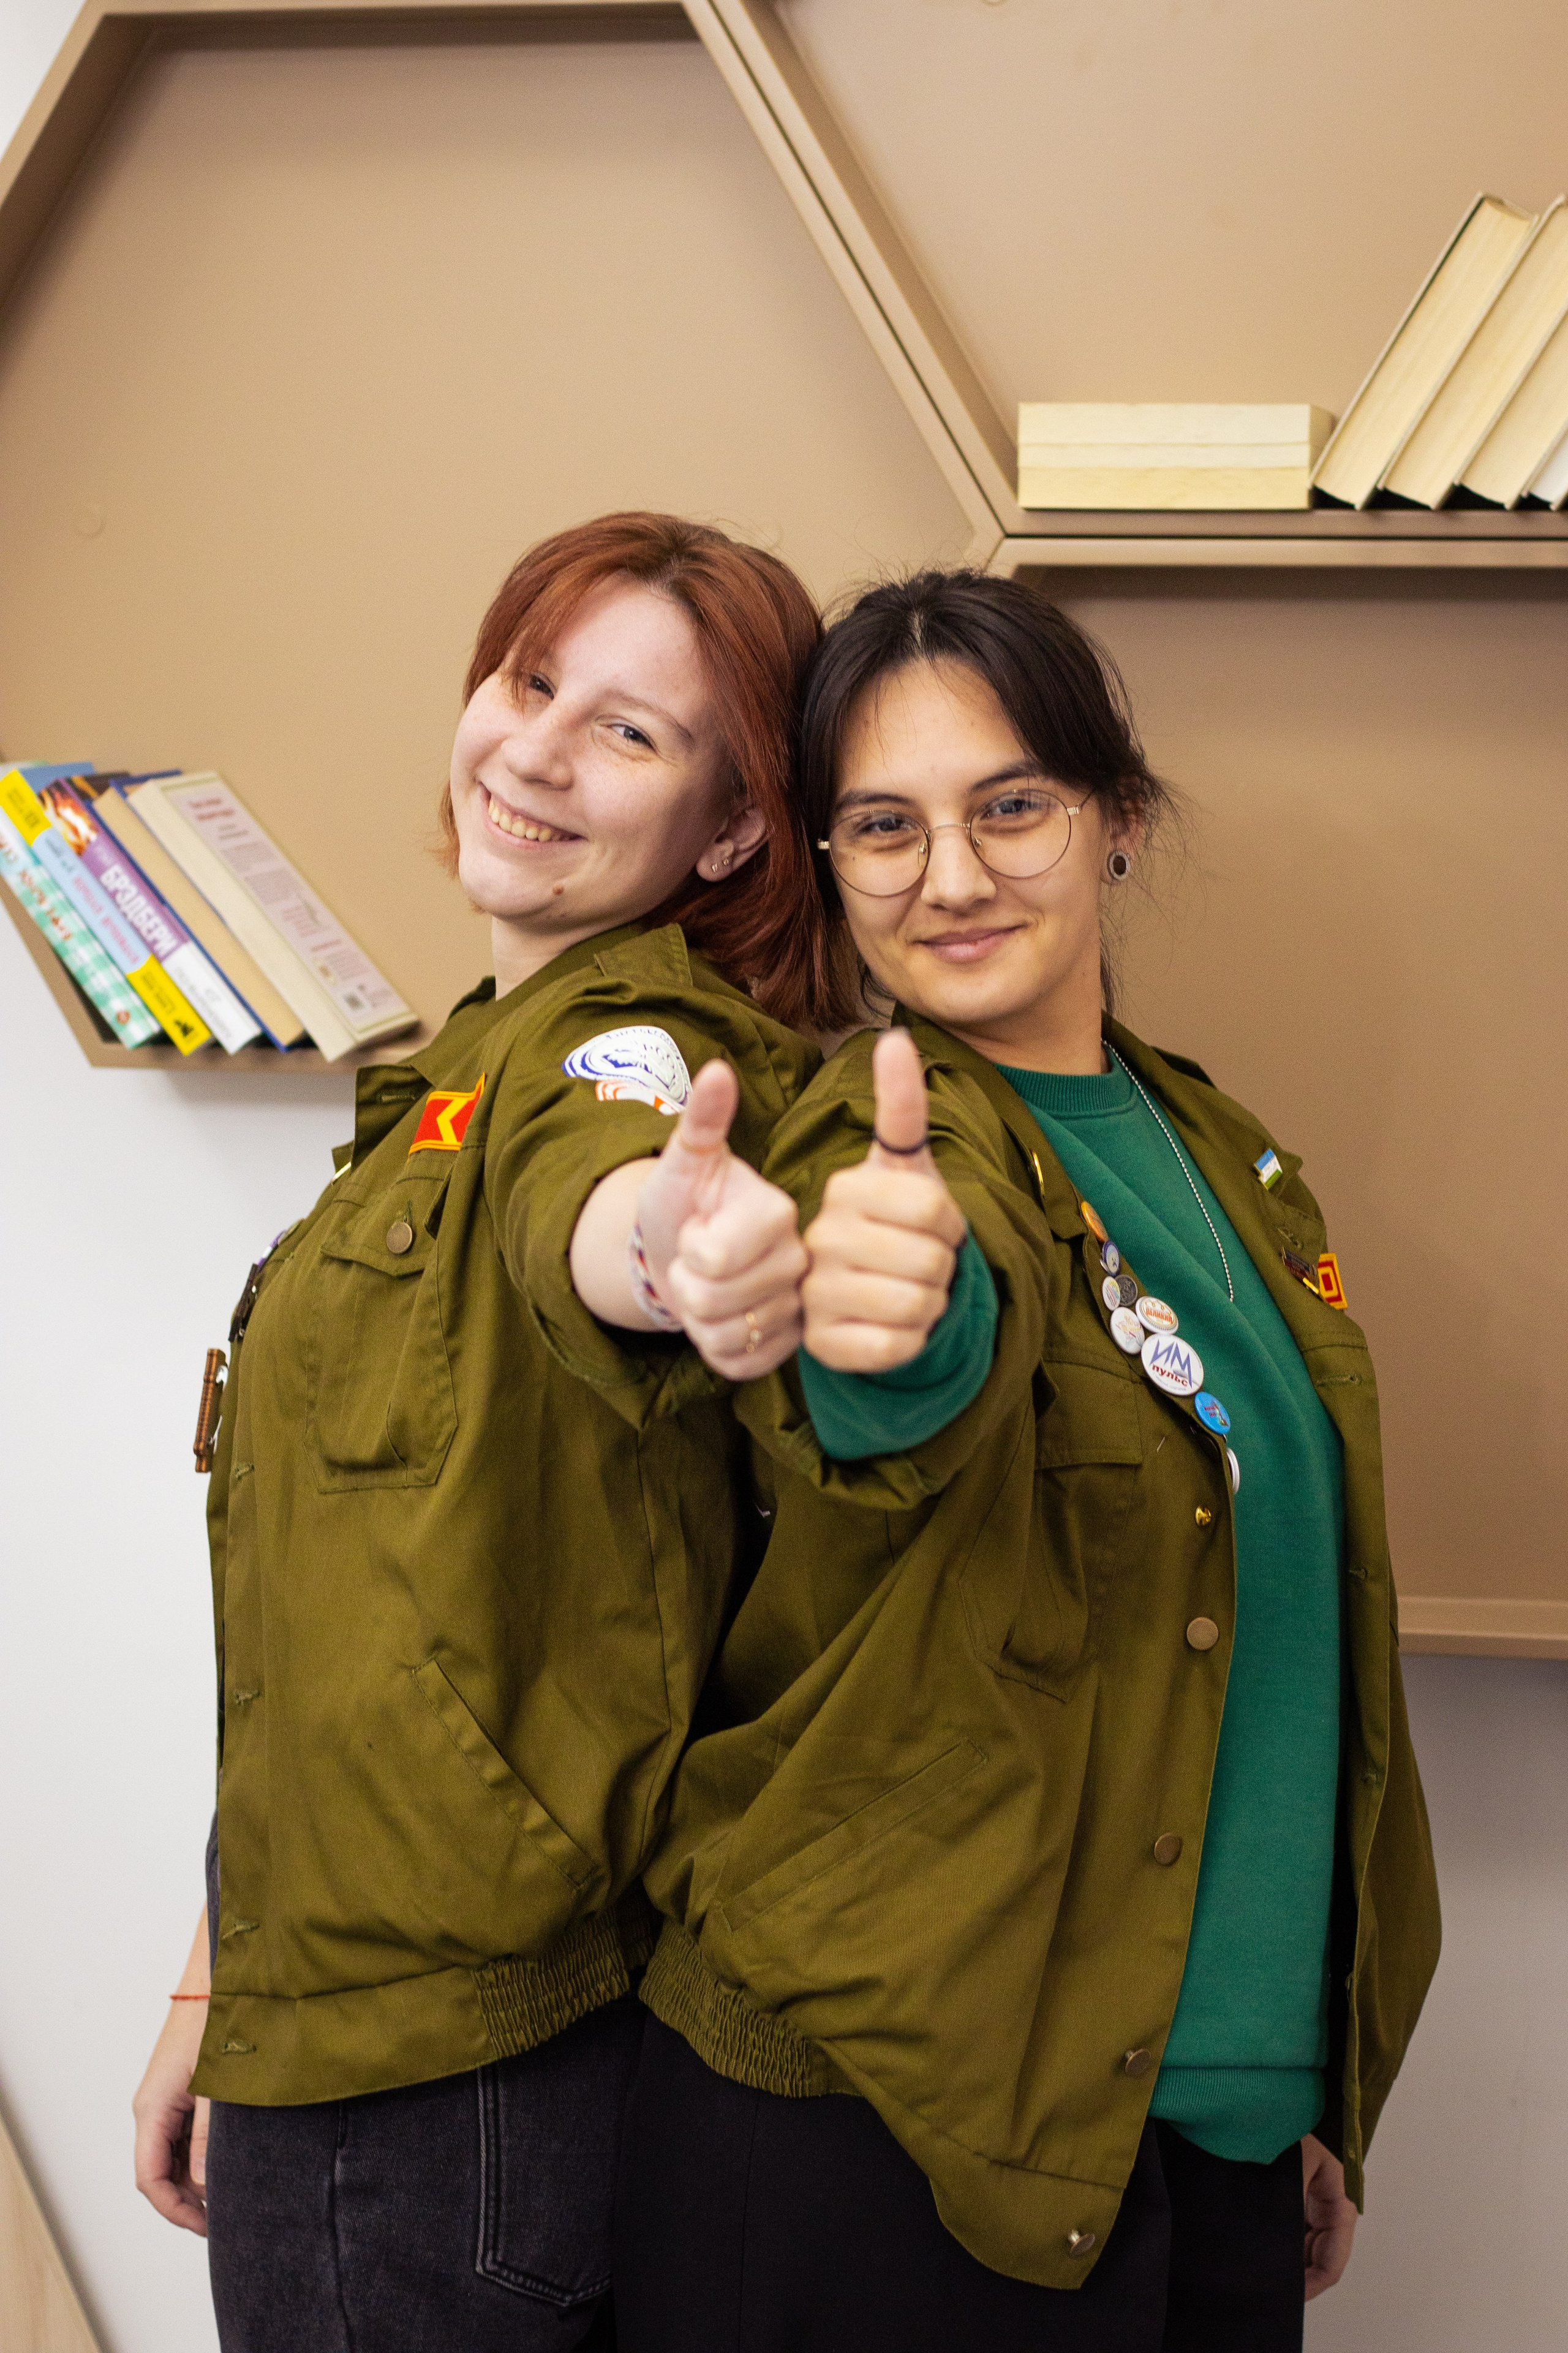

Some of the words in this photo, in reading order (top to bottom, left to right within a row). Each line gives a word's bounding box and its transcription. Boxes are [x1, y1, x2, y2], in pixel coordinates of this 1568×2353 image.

[100, 864, 177, 957] БРЭДБЕРИ
[1149, 1339, 1193, 1389] ИМ
[1152, 1364, 1188, 1387] пульс
